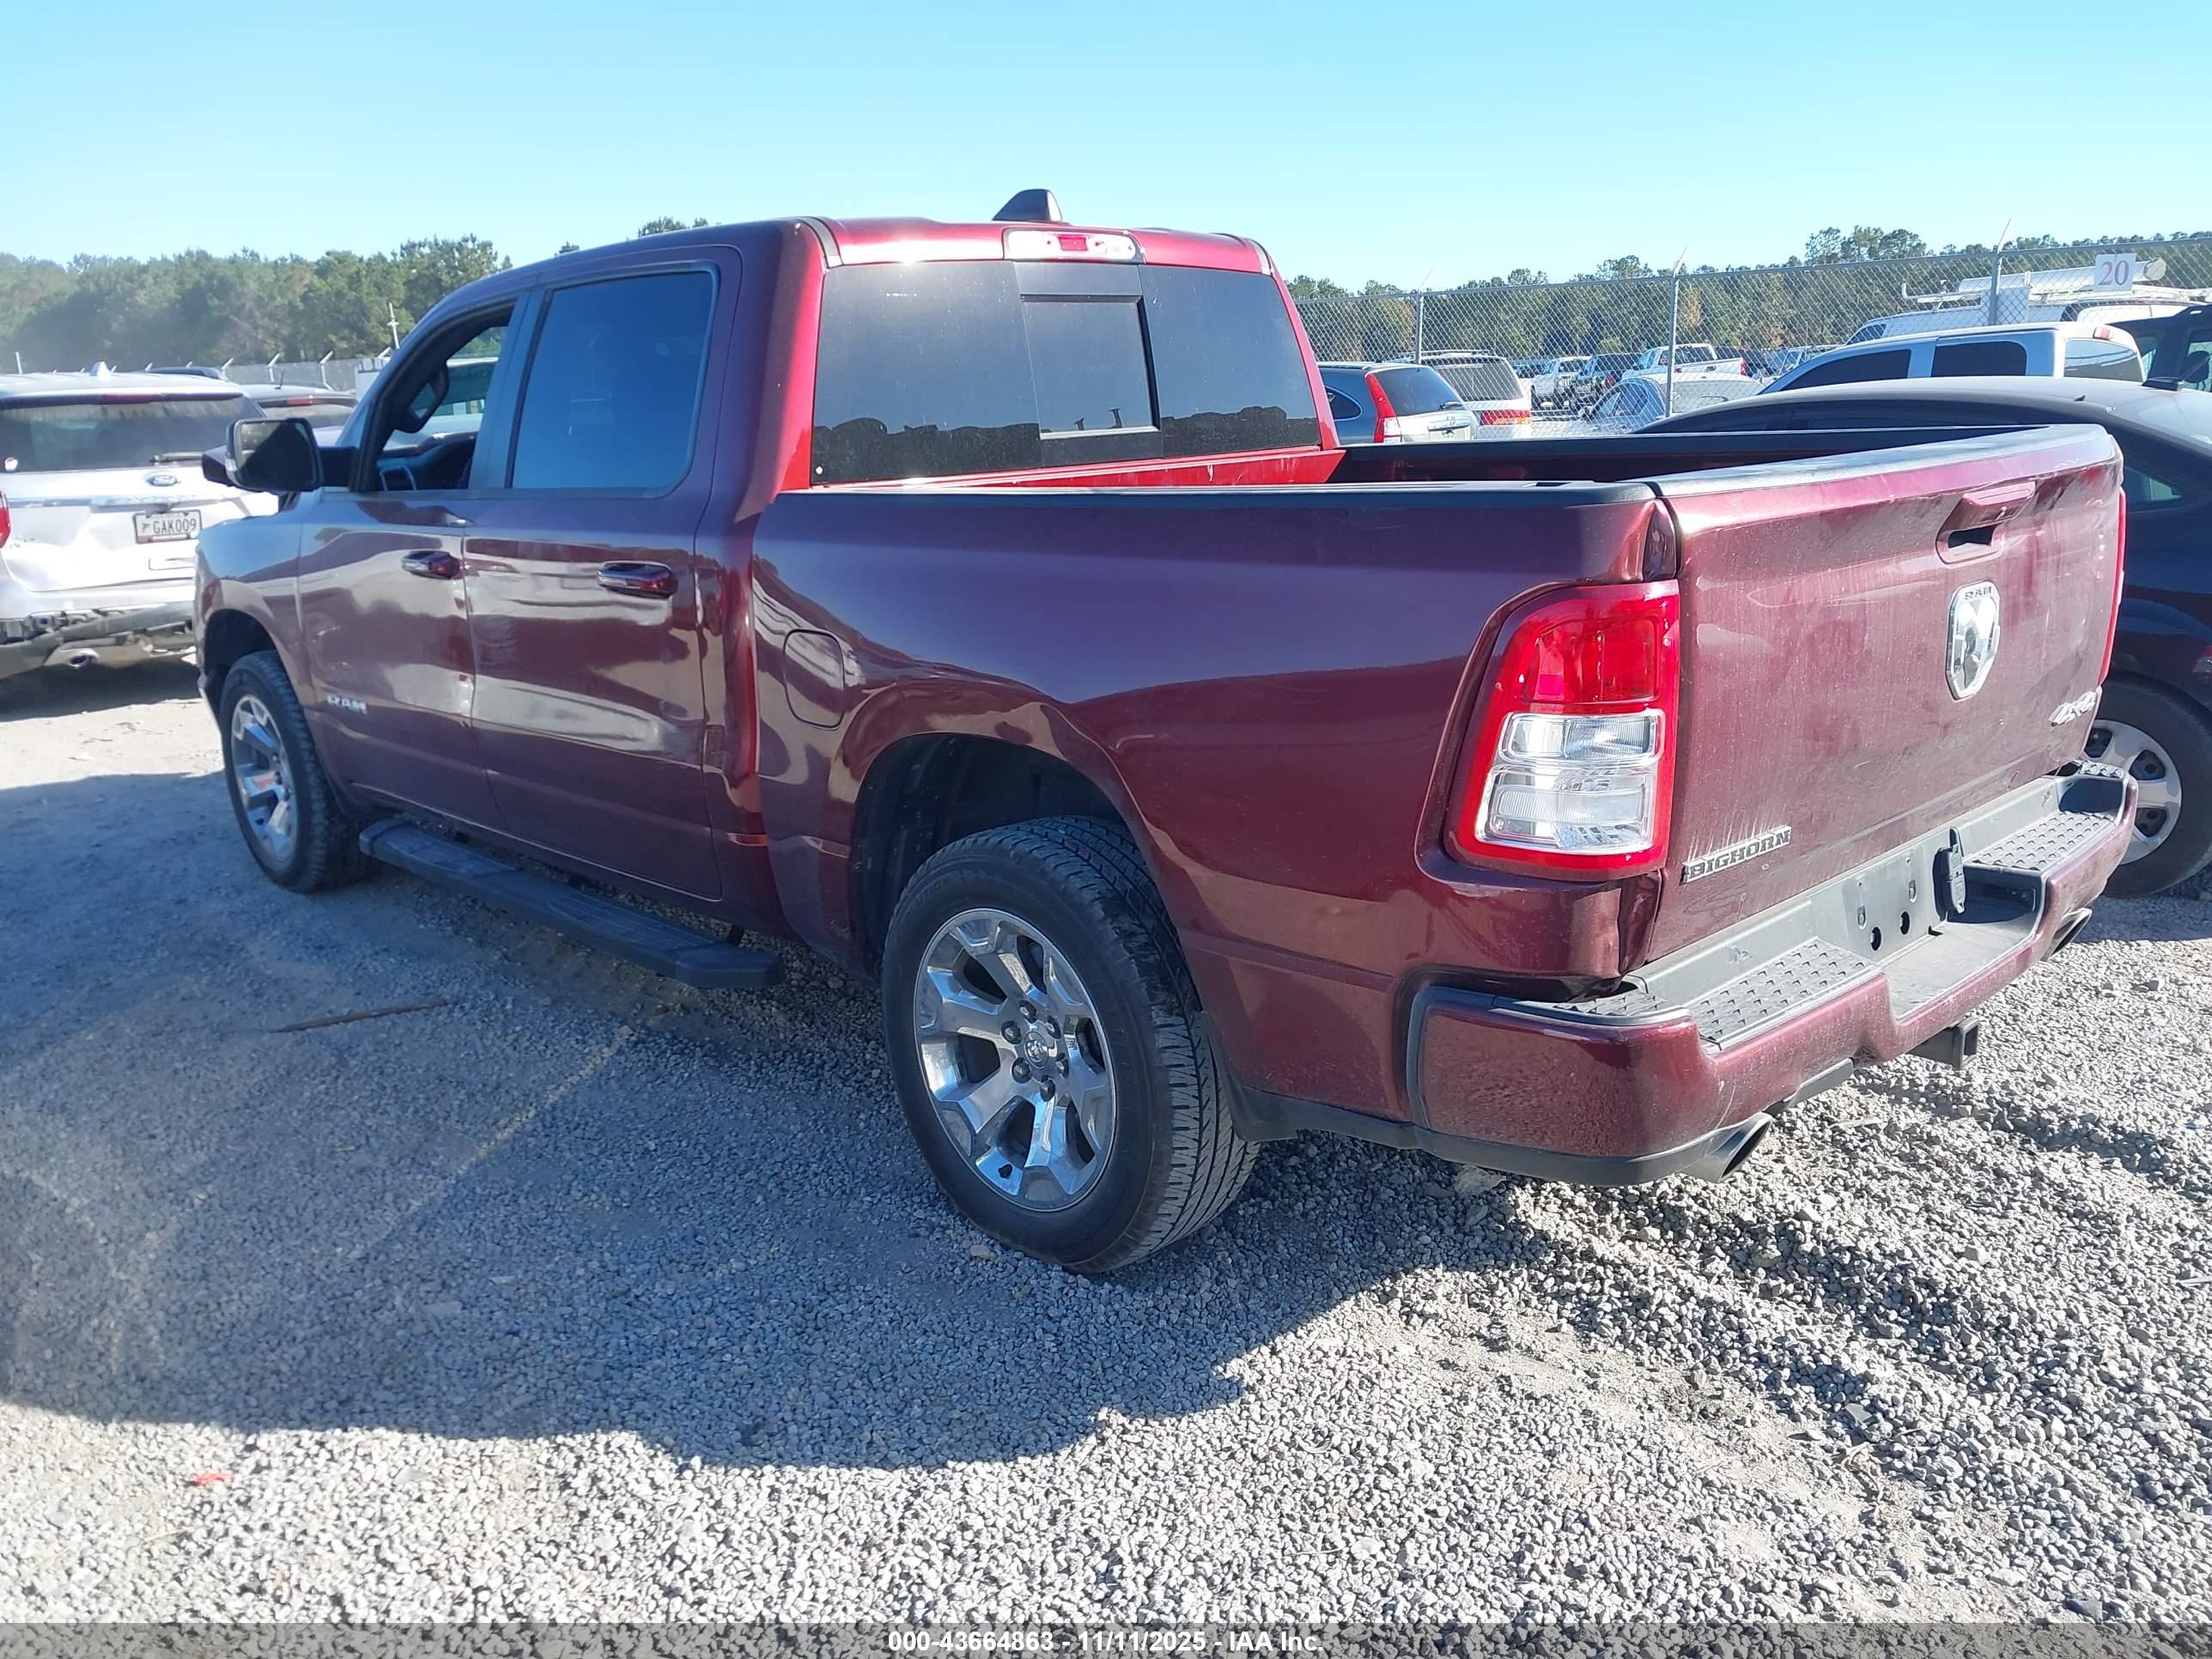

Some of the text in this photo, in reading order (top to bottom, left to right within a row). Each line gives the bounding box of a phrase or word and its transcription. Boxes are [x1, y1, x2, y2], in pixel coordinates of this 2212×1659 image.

[2098, 259, 2130, 286] 20
[152, 518, 197, 534] GAK009
[1964, 586, 1992, 600] RAM
[327, 694, 368, 715] RAM
[1686, 827, 1791, 881] BIGHORN
